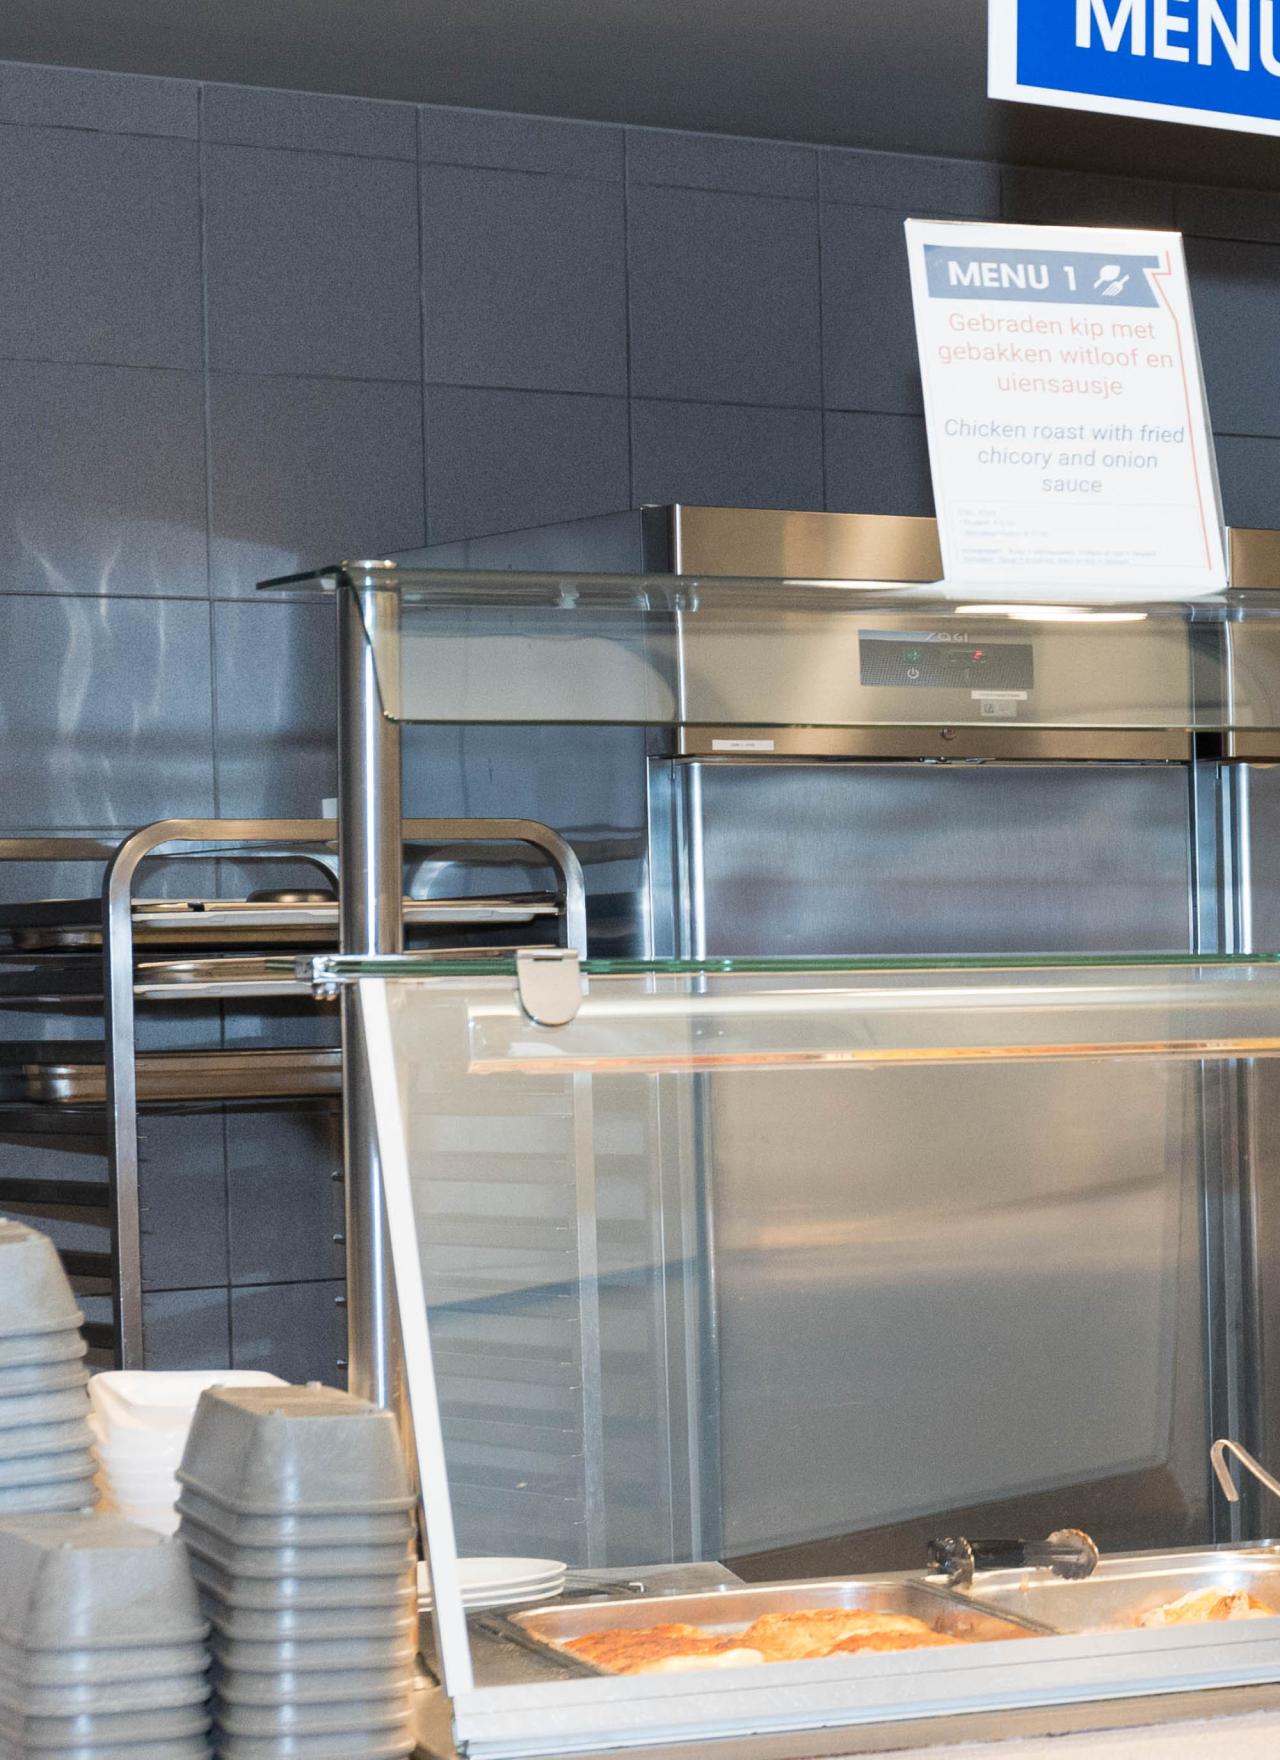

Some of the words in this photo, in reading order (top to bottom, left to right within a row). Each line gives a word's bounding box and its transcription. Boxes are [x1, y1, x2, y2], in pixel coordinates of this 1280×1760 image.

[947, 260, 1050, 290] MENU
[1062, 265, 1078, 291] 1
[948, 313, 1062, 335] Gebraden
[1070, 317, 1104, 341] kip
[1111, 322, 1156, 340] met
[938, 341, 1053, 365] gebakken
[1059, 345, 1139, 367] witloof
[1146, 352, 1174, 369] en
[997, 372, 1124, 400] uiensausje
[943, 418, 1027, 439] Chicken
[1032, 424, 1084, 440] roast
[1091, 424, 1133, 442] with
[1140, 424, 1185, 444] fried
[977, 446, 1052, 470] chicory
[1057, 449, 1096, 467] and
[1101, 451, 1159, 469] onion
[1041, 477, 1103, 494] sauce
